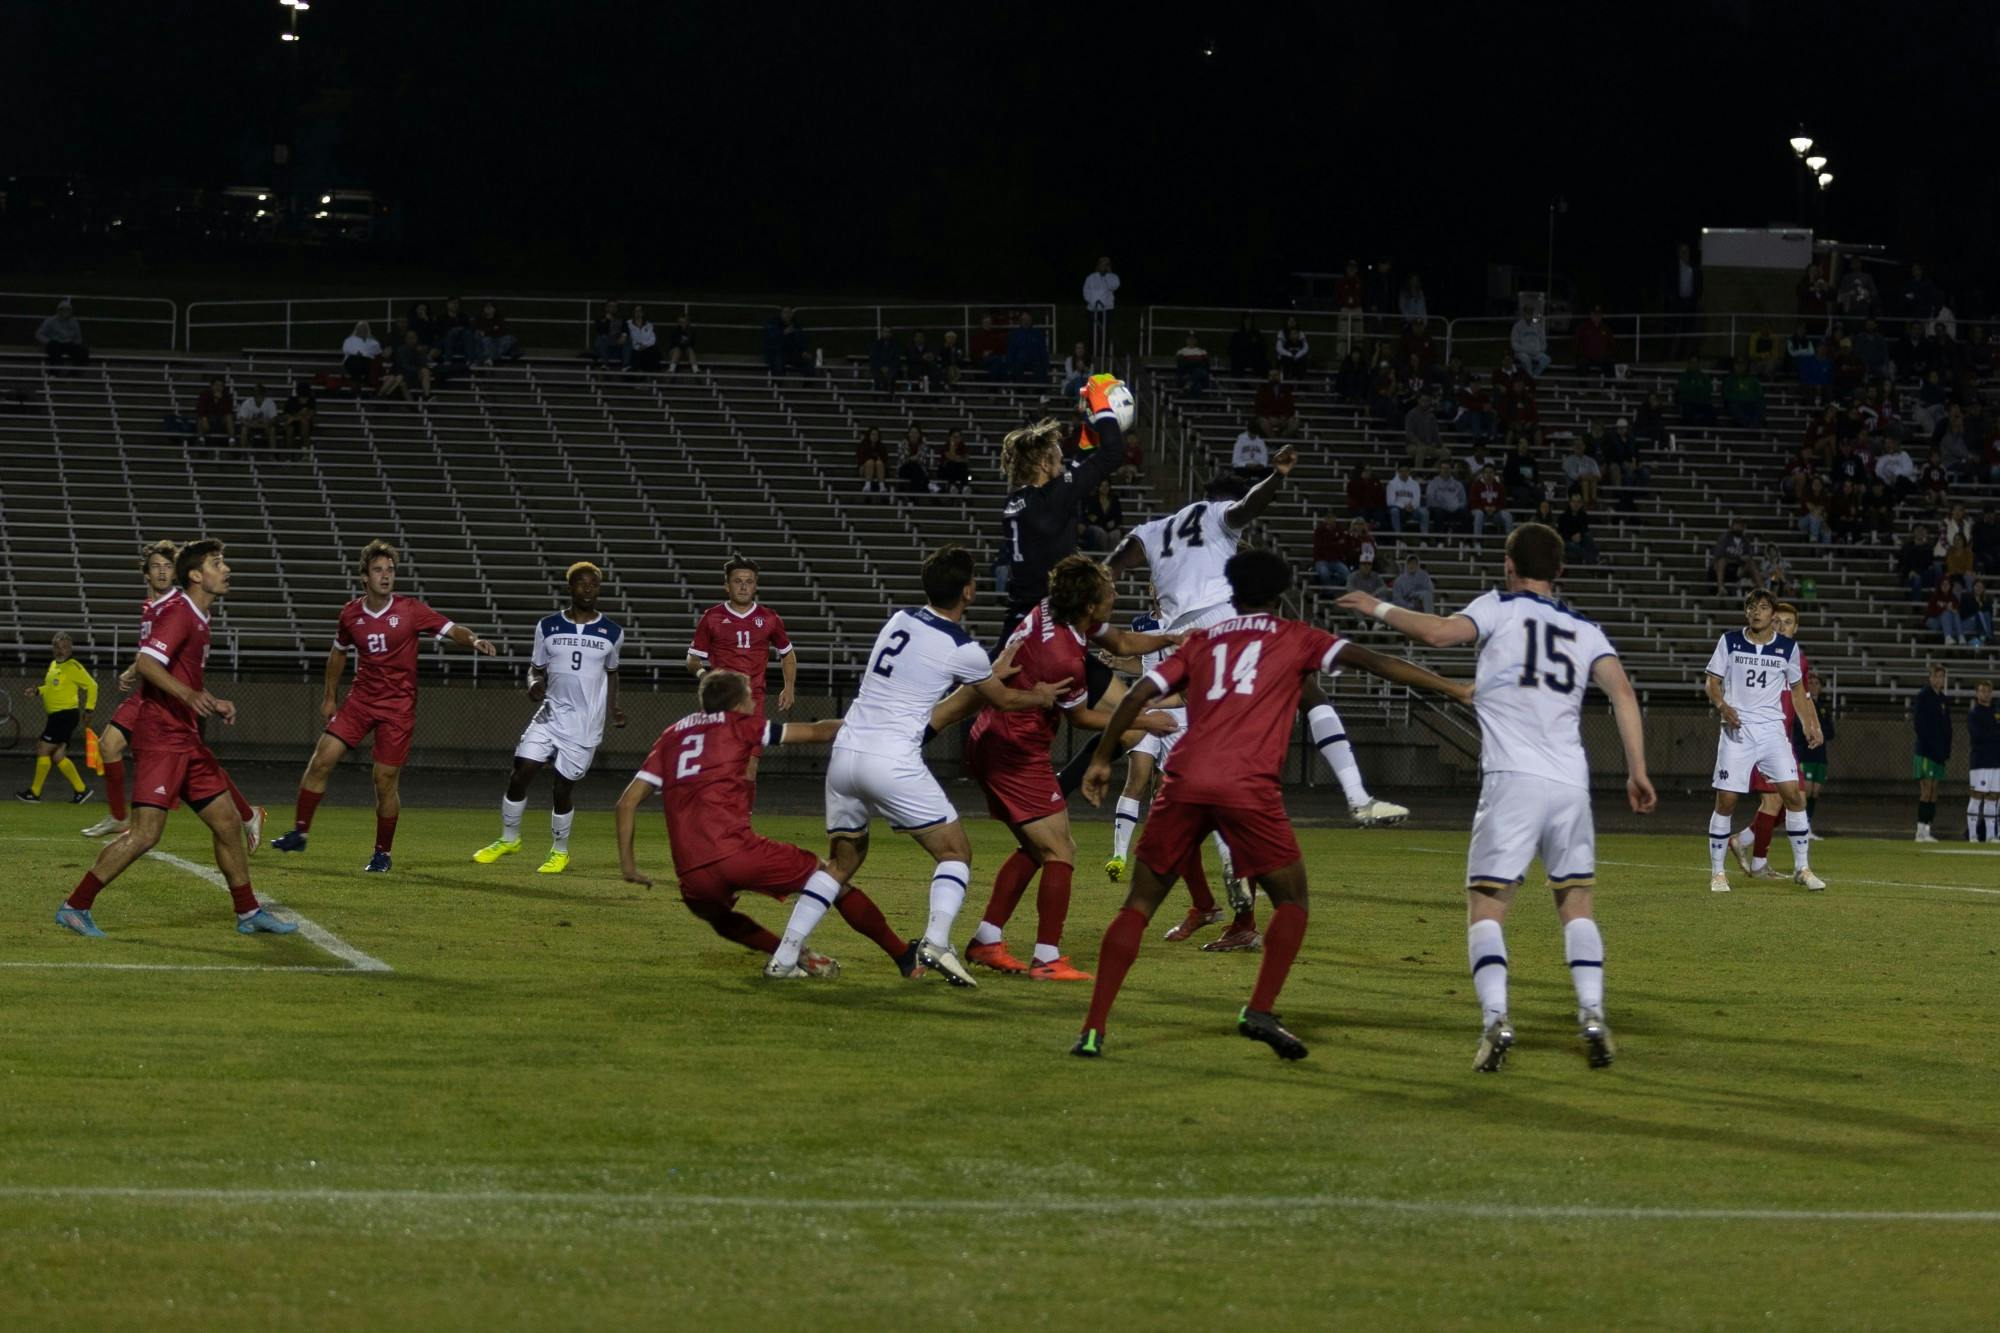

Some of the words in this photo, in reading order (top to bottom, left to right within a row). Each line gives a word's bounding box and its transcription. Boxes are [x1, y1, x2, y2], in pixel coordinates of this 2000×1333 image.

[1010, 519, 1024, 562] 1
[1160, 504, 1208, 557] 14
[735, 630, 751, 649] 11
[1207, 617, 1278, 640] INDIANA
[367, 633, 388, 653] 21
[552, 637, 579, 647] NOTRE
[581, 638, 606, 651] DAME
[873, 629, 911, 678] 2
[571, 651, 582, 671] 9
[1519, 617, 1576, 695] 15
[1735, 655, 1759, 666] NOTRE
[1760, 658, 1782, 669] DAME
[1206, 639, 1264, 701] 14
[1746, 669, 1767, 688] 24
[676, 733, 705, 779] 2
